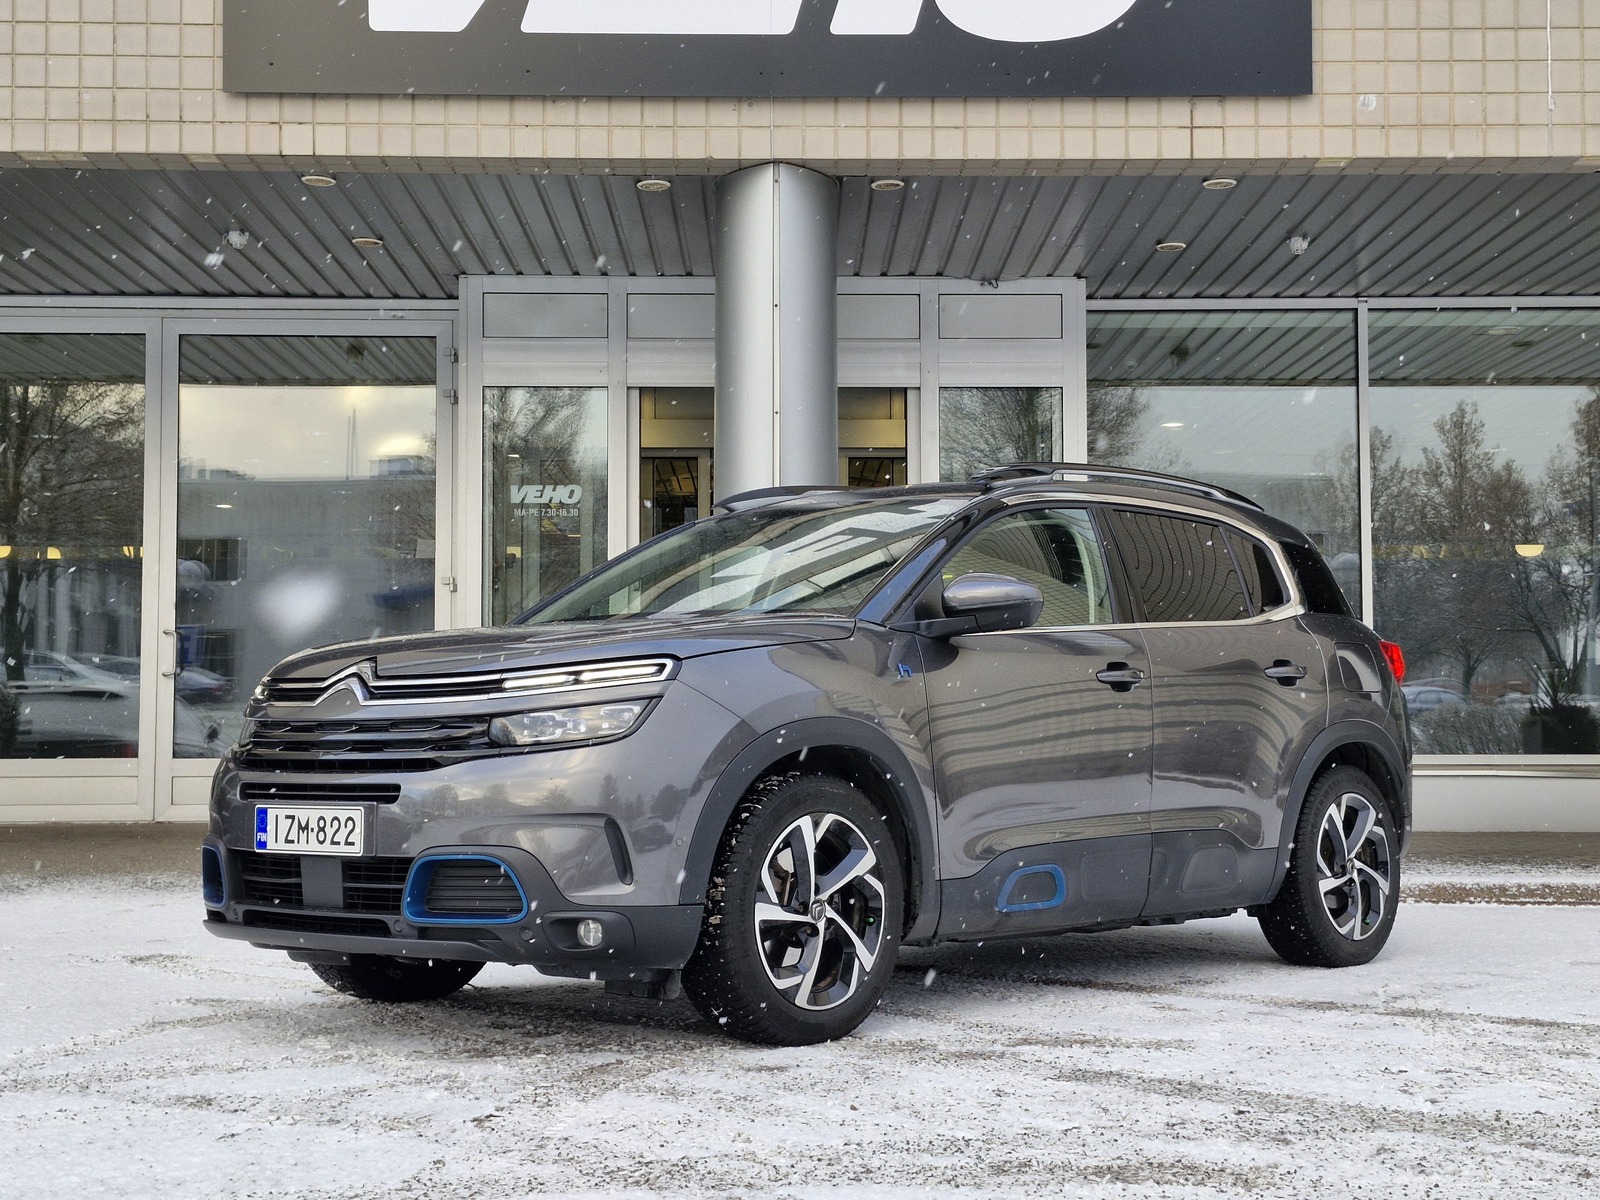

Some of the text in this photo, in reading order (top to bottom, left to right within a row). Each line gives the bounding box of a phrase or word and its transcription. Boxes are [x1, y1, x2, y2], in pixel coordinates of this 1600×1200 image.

[510, 484, 583, 504] VEHO
[513, 508, 539, 517] MA-PE
[257, 832, 268, 842] FIN
[274, 814, 357, 847] IZM-822
